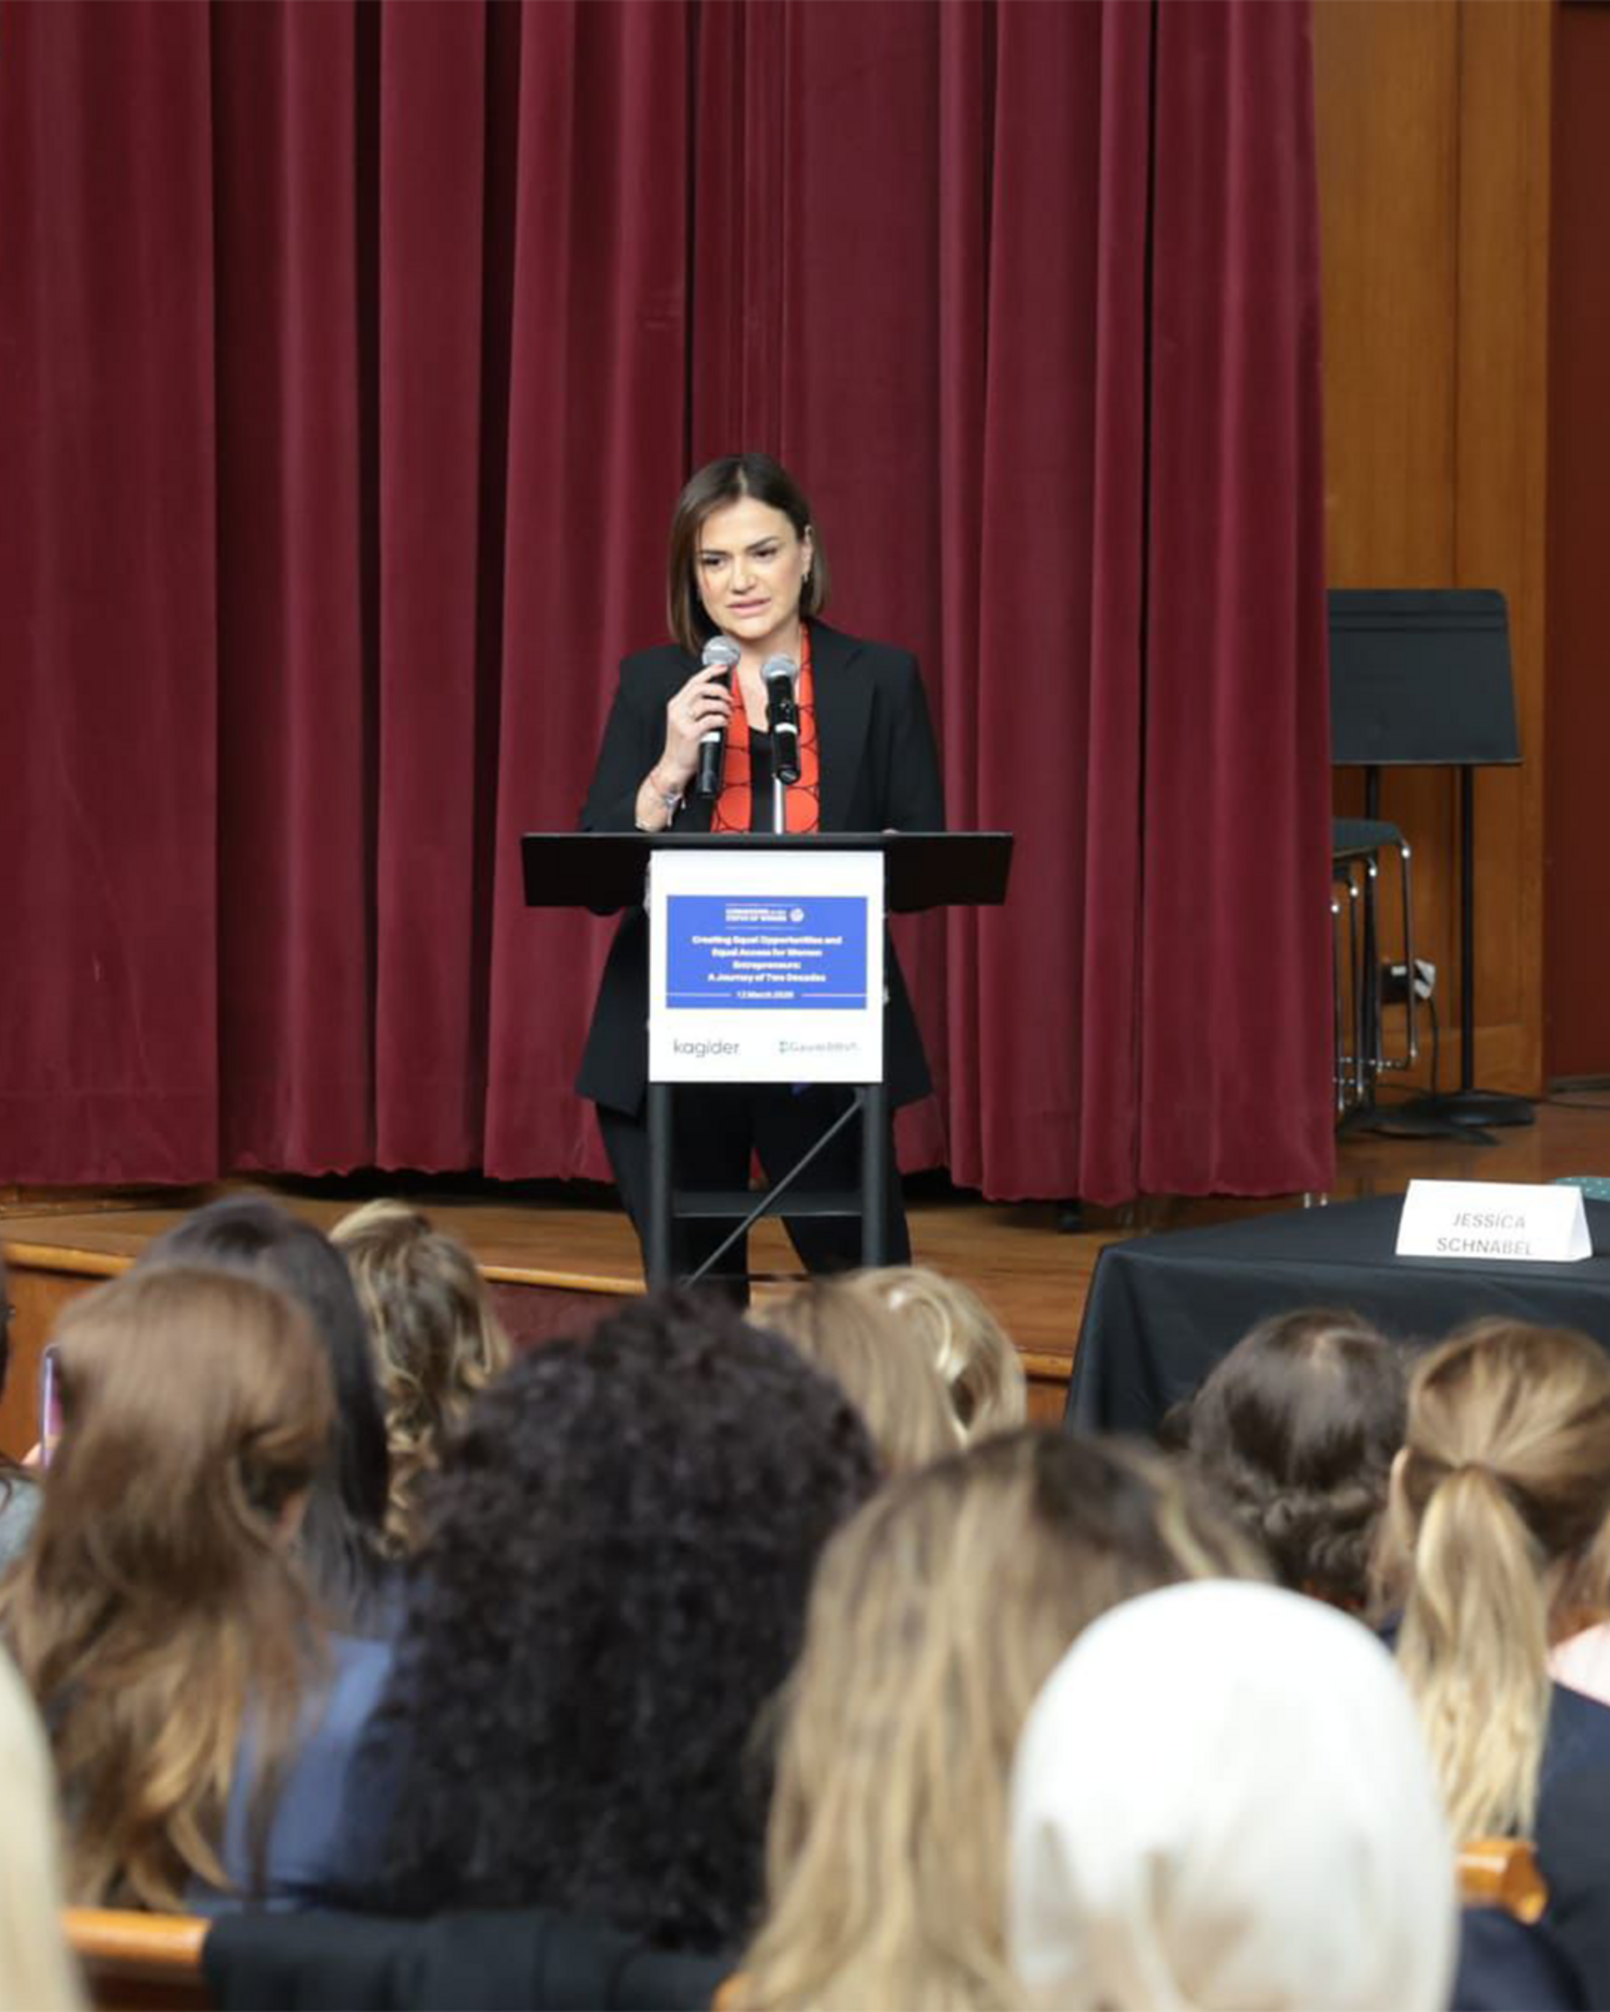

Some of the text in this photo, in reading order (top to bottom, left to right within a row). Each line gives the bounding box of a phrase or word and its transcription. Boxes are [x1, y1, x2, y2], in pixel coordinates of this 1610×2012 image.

[673, 1038, 740, 1057] kagider
[1452, 1212, 1526, 1230] JESSICA
[1436, 1236, 1534, 1256] SCHNABEL
